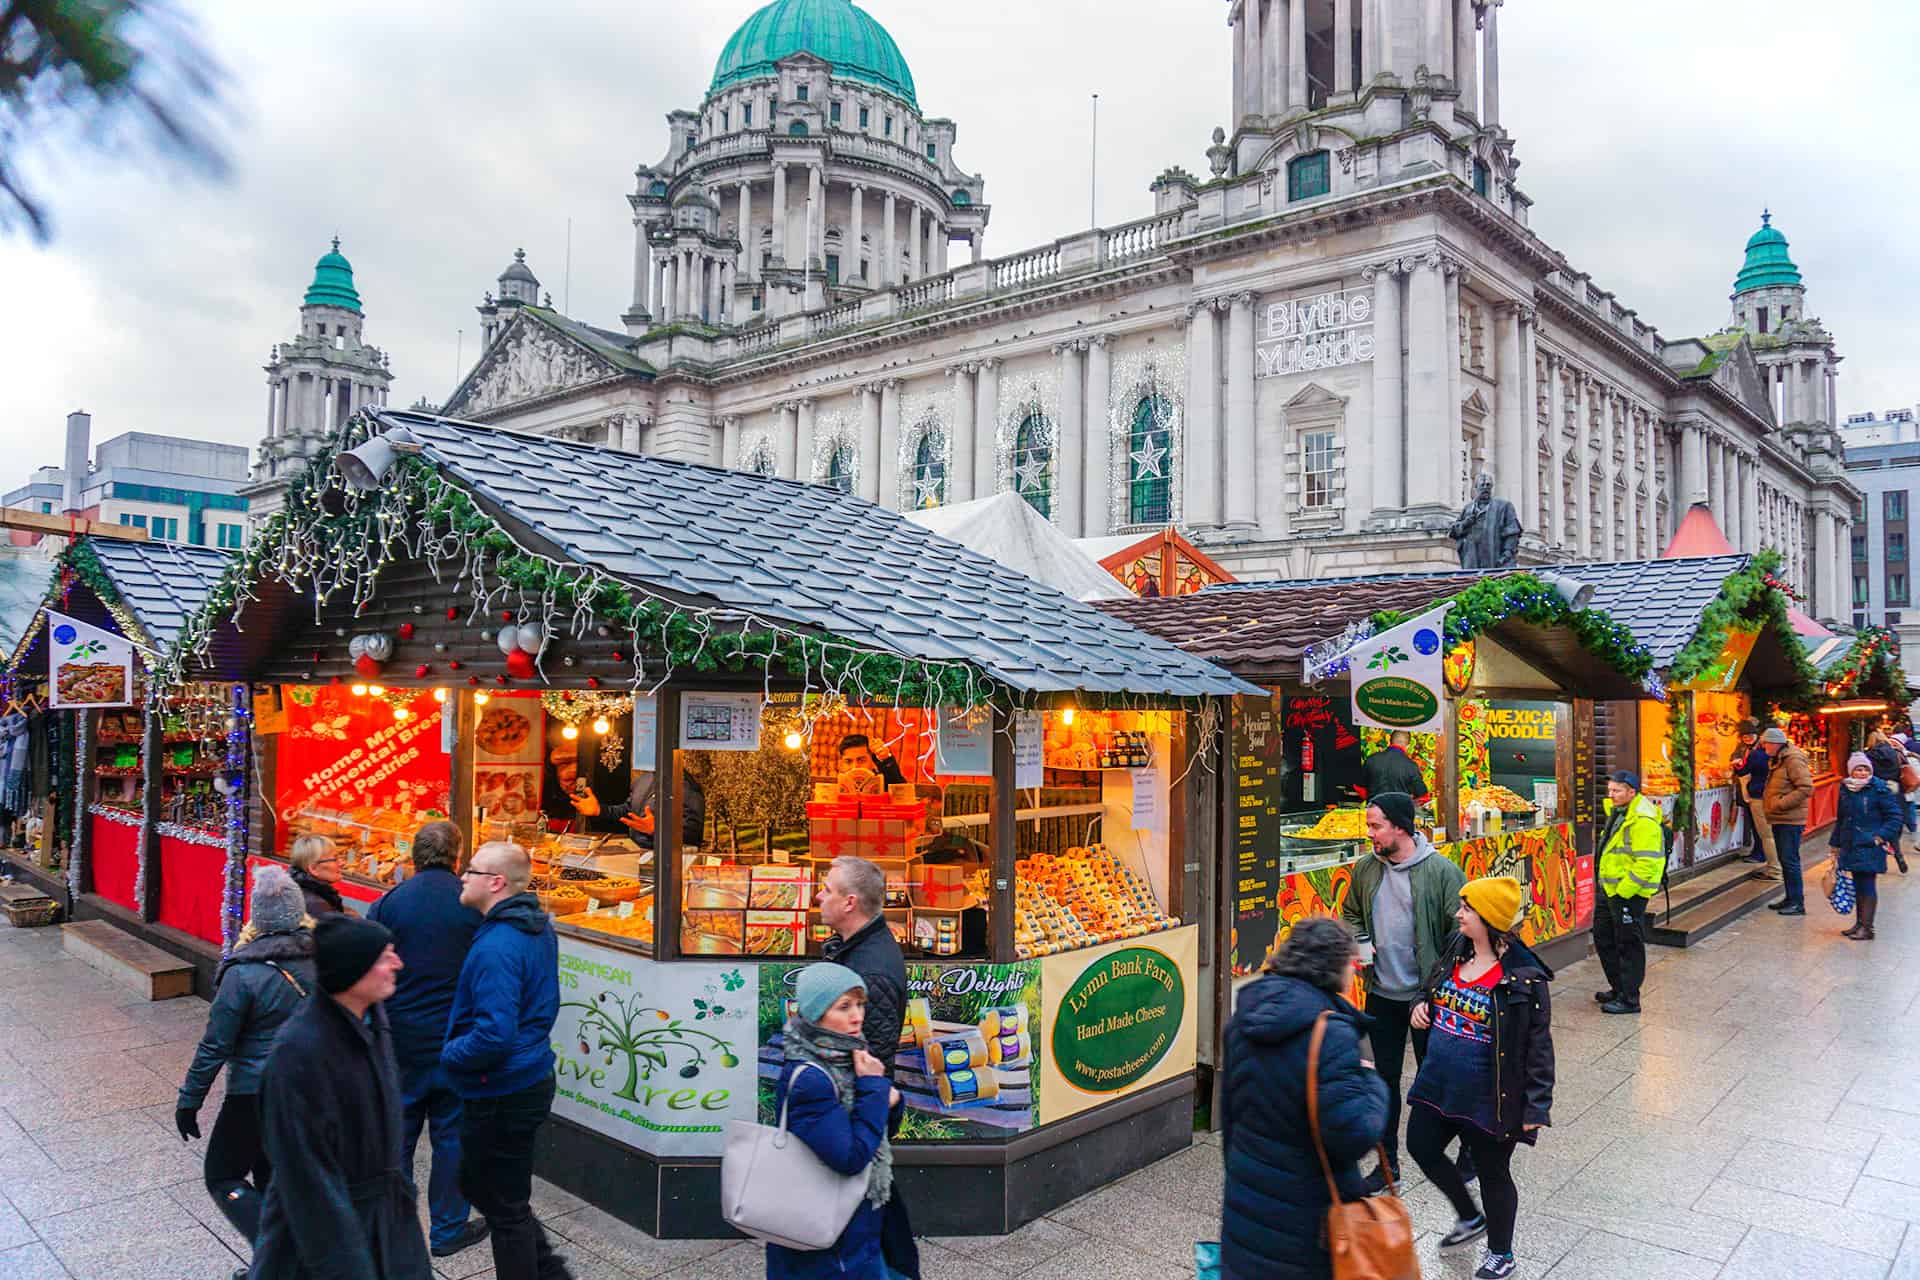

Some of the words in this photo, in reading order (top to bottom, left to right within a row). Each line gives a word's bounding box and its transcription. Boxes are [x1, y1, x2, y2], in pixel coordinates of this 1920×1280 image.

[1267, 294, 1370, 339] Blythe
[1257, 330, 1376, 377] Yuletide
[1486, 724, 1556, 740] NOODLE
[1488, 709, 1556, 724] MEXICA
[281, 740, 397, 821] Continental
[398, 711, 442, 744] Brea
[303, 748, 363, 791] Home
[354, 747, 419, 795] Pastries
[940, 967, 1026, 1000] Delights
[1111, 955, 1142, 980] Bank
[1145, 957, 1176, 992] Farm
[1076, 1018, 1105, 1041] Hand
[1106, 1010, 1134, 1033] Made
[1135, 1004, 1168, 1024] Cheese
[1075, 1032, 1166, 1083] www.postacheese.com
